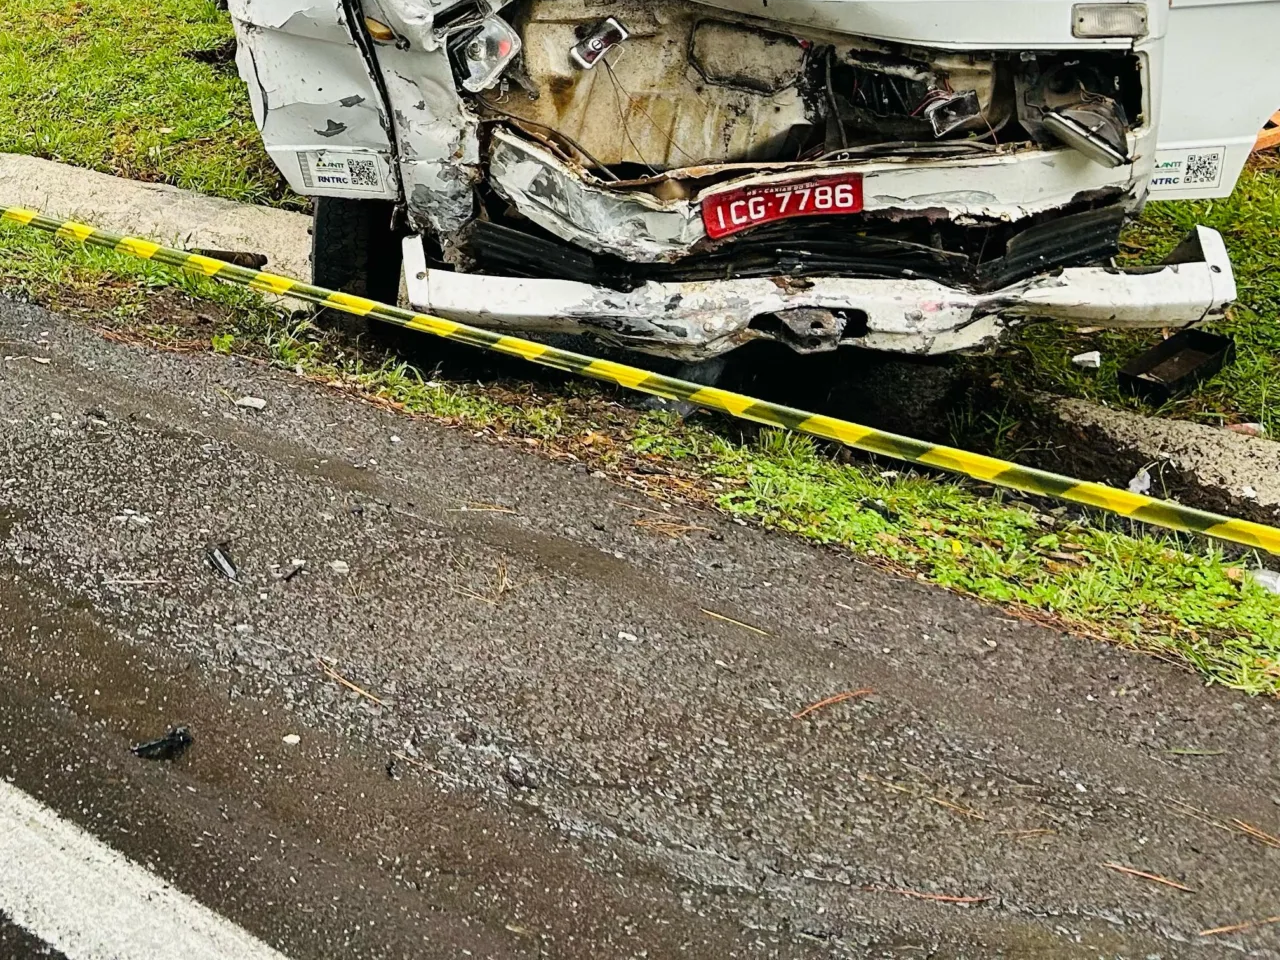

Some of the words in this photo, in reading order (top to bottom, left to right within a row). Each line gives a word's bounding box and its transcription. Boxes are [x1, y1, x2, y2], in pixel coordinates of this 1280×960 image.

[1161, 161, 1182, 169] ANTT
[317, 176, 349, 184] RNTRC
[1151, 177, 1180, 186] NTRC
